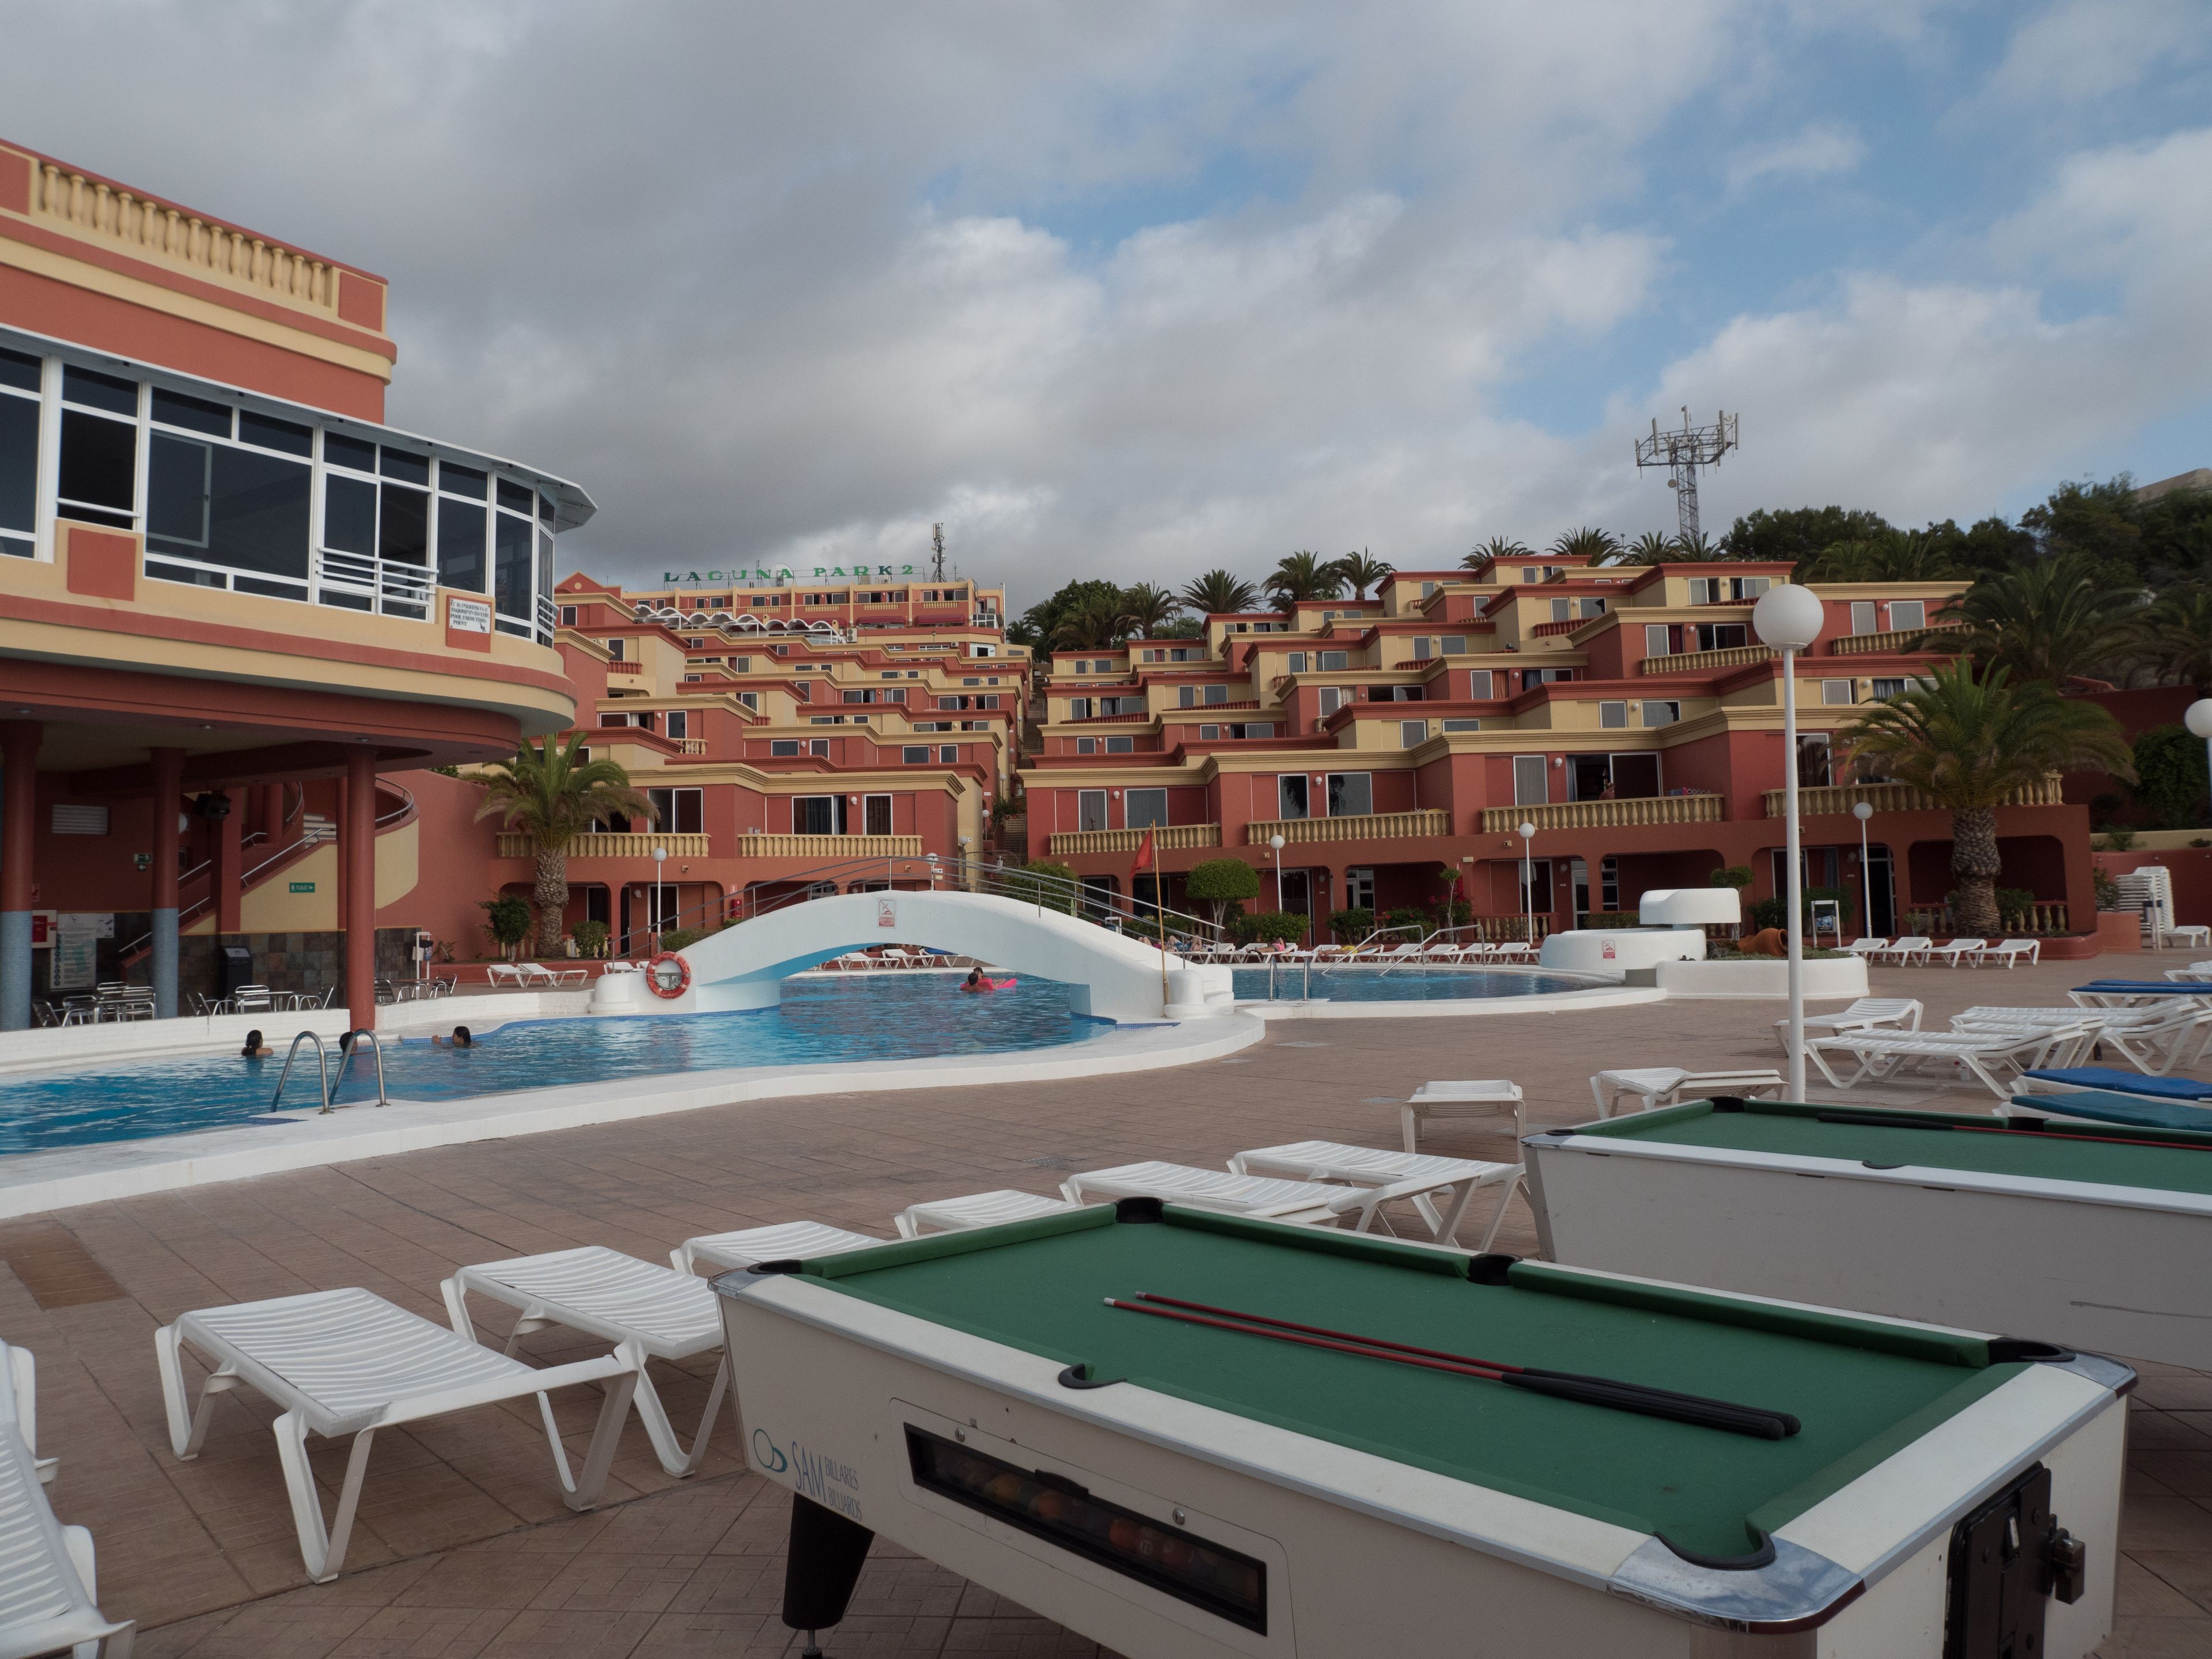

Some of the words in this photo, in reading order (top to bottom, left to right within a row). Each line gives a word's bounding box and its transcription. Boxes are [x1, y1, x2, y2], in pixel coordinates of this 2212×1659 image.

[664, 569, 794, 582] LAGUNA
[813, 566, 892, 577] PARK
[792, 1441, 826, 1502] SAM
[824, 1456, 858, 1491] BILLARES
[828, 1487, 862, 1521] BILLIARDS
